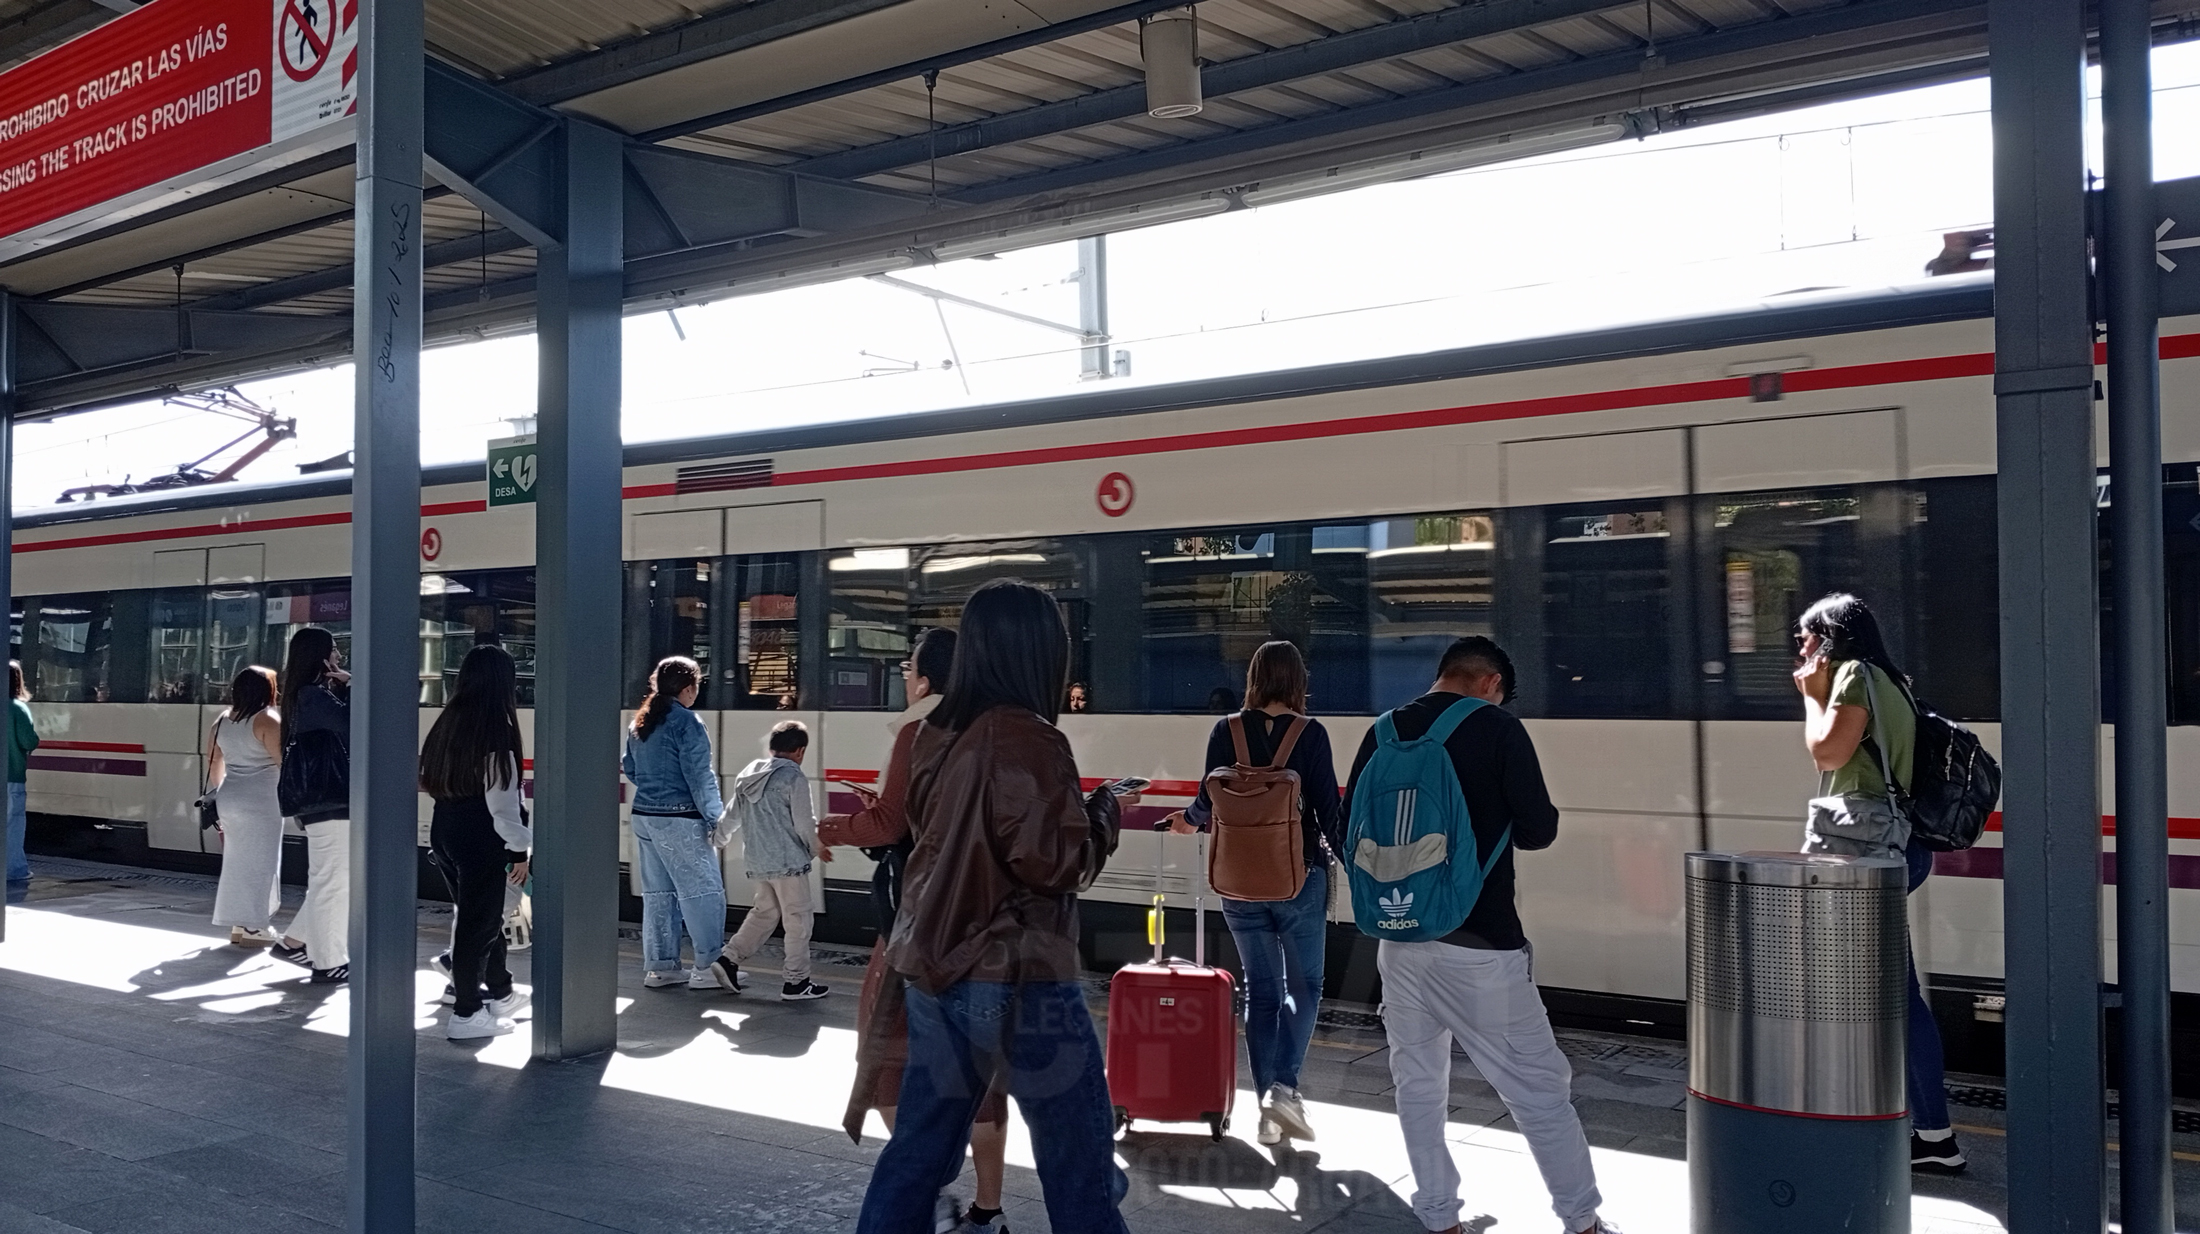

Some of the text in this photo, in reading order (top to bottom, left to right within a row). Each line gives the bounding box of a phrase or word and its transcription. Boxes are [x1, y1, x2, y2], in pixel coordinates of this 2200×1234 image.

[77, 60, 143, 109] CRUZAR
[147, 43, 181, 80] LAS
[186, 22, 228, 63] VÍAS
[0, 68, 262, 193] SING THE TRACK IS PROHIBITED
[495, 486, 516, 497] DESA
[1377, 919, 1419, 930] adidas
